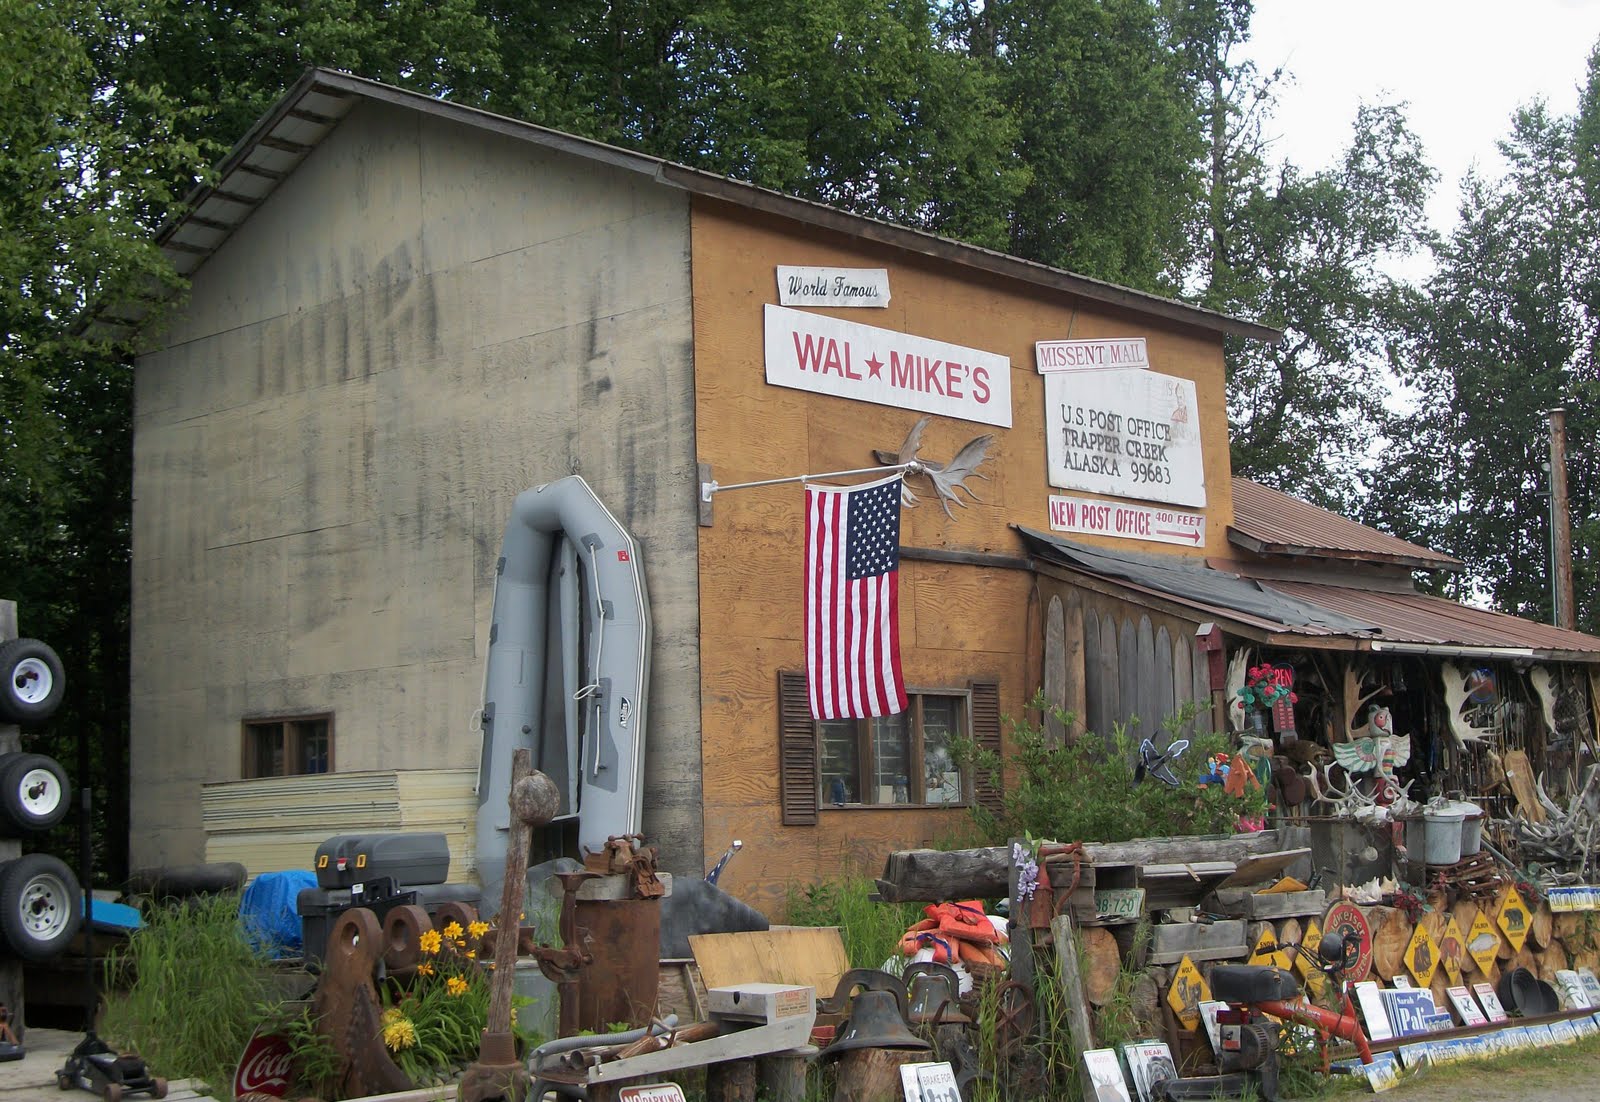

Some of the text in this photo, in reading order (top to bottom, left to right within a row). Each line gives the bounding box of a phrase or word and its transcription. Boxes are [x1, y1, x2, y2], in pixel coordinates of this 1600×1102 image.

[788, 275, 879, 298] World Famous
[1039, 343, 1145, 367] MISSENT MAIL
[792, 330, 992, 404] WAL MIKE'S
[1088, 409, 1123, 433] POST
[1127, 417, 1172, 442] OFFICE
[1062, 427, 1169, 463] TRAPPER CREEK
[1063, 449, 1172, 485] ALASKA 99683
[1051, 500, 1151, 536] NEW POST OFFICE
[1155, 511, 1204, 527] 400 FEET
[1274, 668, 1293, 687] PEN
[1330, 907, 1367, 937] dweiser
[1414, 934, 1430, 944] DEAD
[1181, 966, 1193, 974] WOLF
[1418, 970, 1431, 979] END
[1396, 995, 1415, 1005] Sarah
[1399, 1006, 1426, 1031] Pali
[1143, 1049, 1163, 1057] BEAR
[240, 1045, 293, 1091] Coca
[922, 1072, 952, 1086] BRAKE FOR
